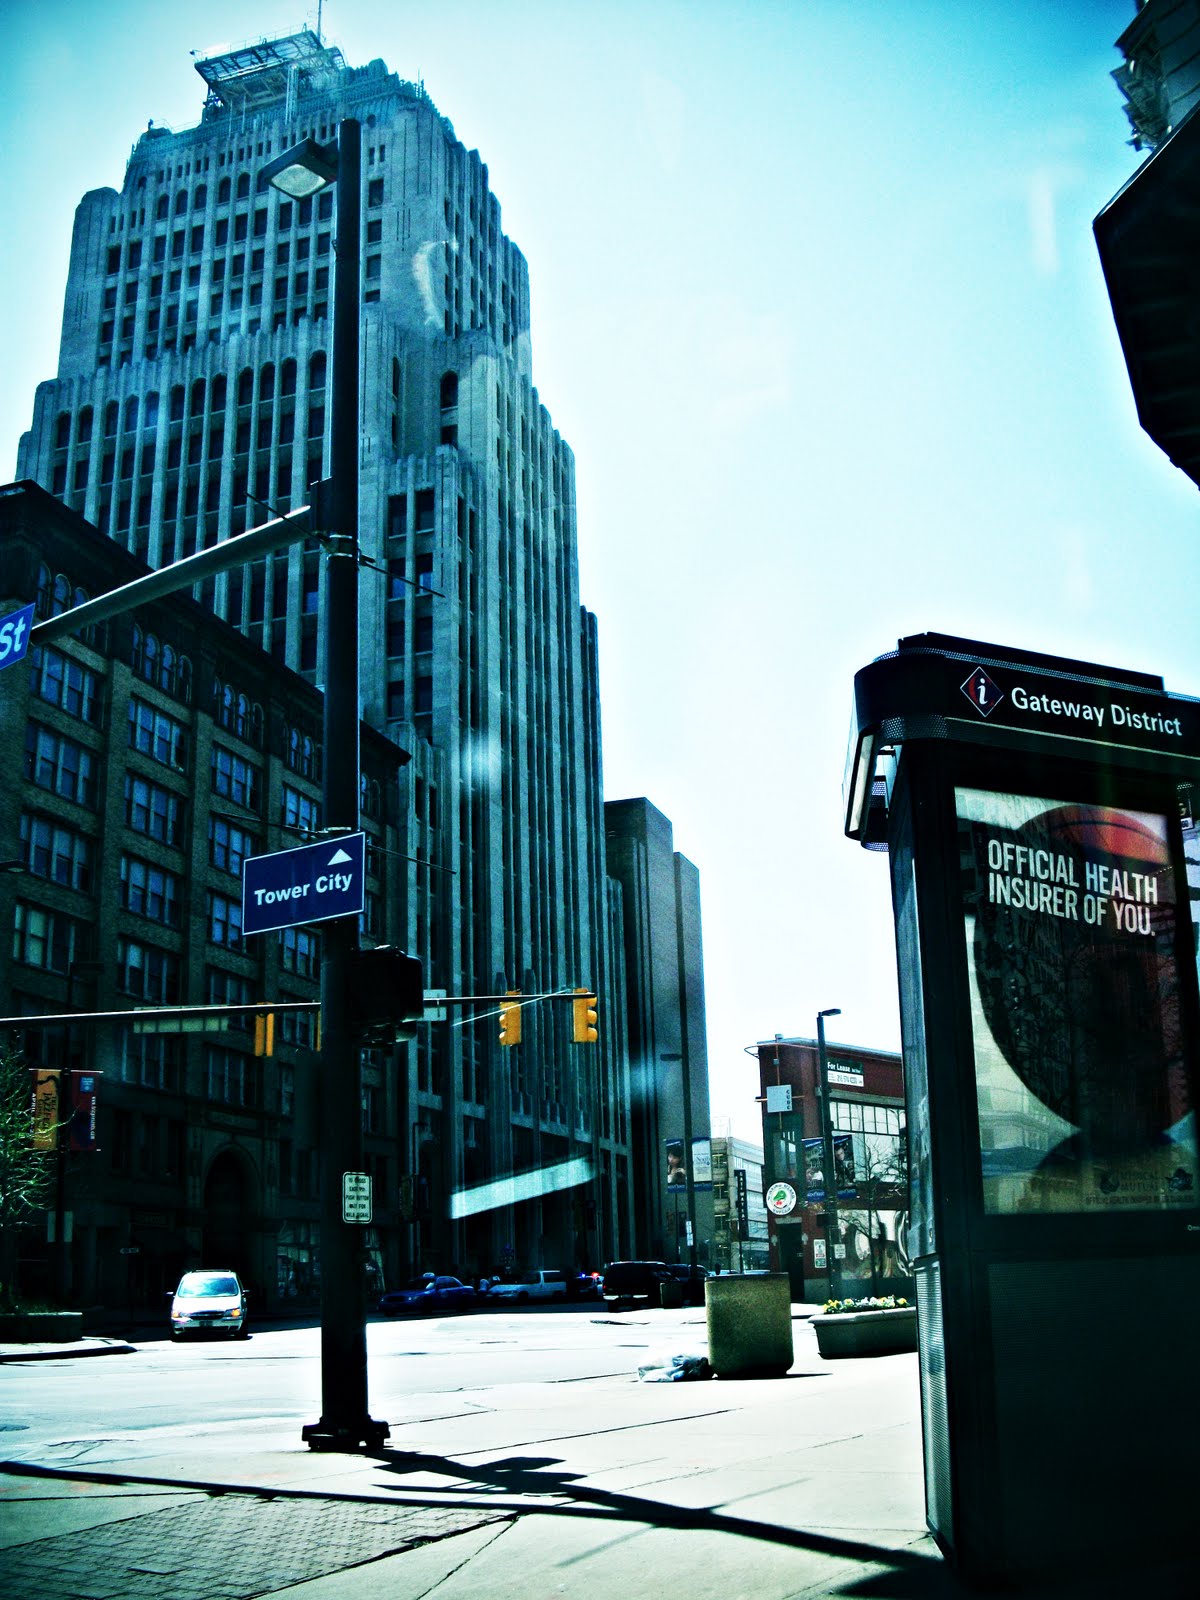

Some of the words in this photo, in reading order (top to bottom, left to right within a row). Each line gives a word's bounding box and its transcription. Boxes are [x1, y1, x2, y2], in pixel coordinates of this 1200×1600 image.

[0, 616, 26, 661] St
[1011, 687, 1105, 727] Gateway
[1111, 704, 1183, 736] District
[254, 883, 311, 906] Tower
[315, 873, 353, 893] City
[988, 839, 1080, 888] OFFICIAL
[1085, 861, 1158, 905] HEALTH
[989, 872, 1079, 921] INSURER
[1083, 893, 1108, 926] OF
[1112, 901, 1156, 937] YOU.
[827, 1061, 836, 1070] For
[836, 1063, 851, 1073] Lease
